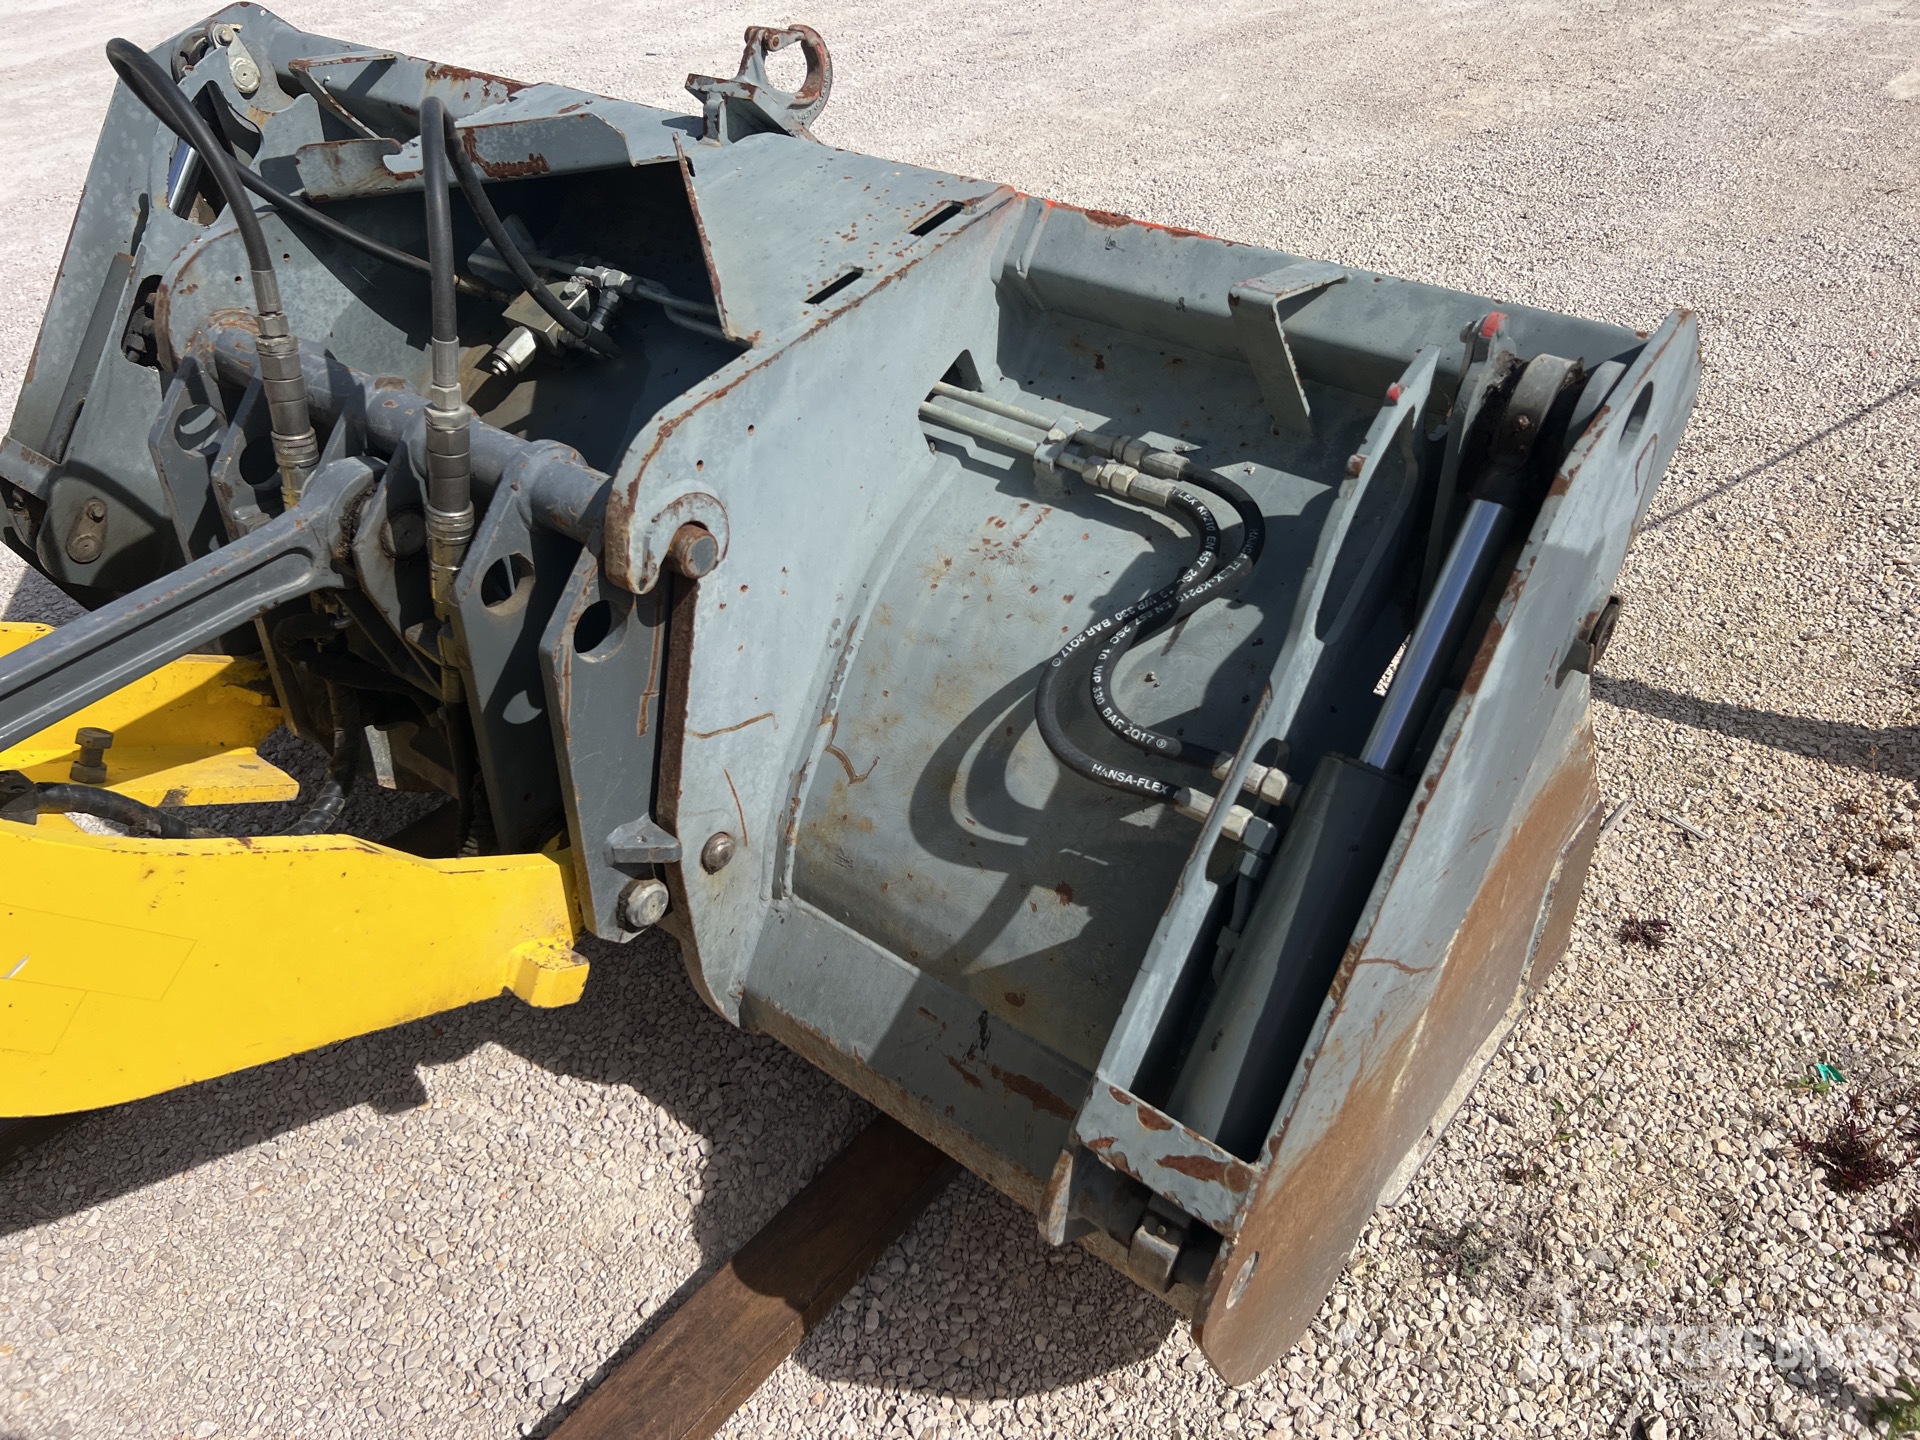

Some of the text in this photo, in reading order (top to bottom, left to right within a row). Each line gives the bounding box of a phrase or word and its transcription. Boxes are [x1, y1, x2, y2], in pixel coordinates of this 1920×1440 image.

[1205, 535, 1217, 550] EN
[1114, 606, 1135, 621] 330
[1085, 618, 1111, 637] BAR
[1109, 625, 1131, 644] 2SC
[1061, 634, 1086, 658] 2Q17
[1097, 648, 1110, 660] 10
[1092, 665, 1103, 683] WP
[1092, 686, 1105, 705] 330
[1091, 763, 1169, 795] HANSA-FLEX
